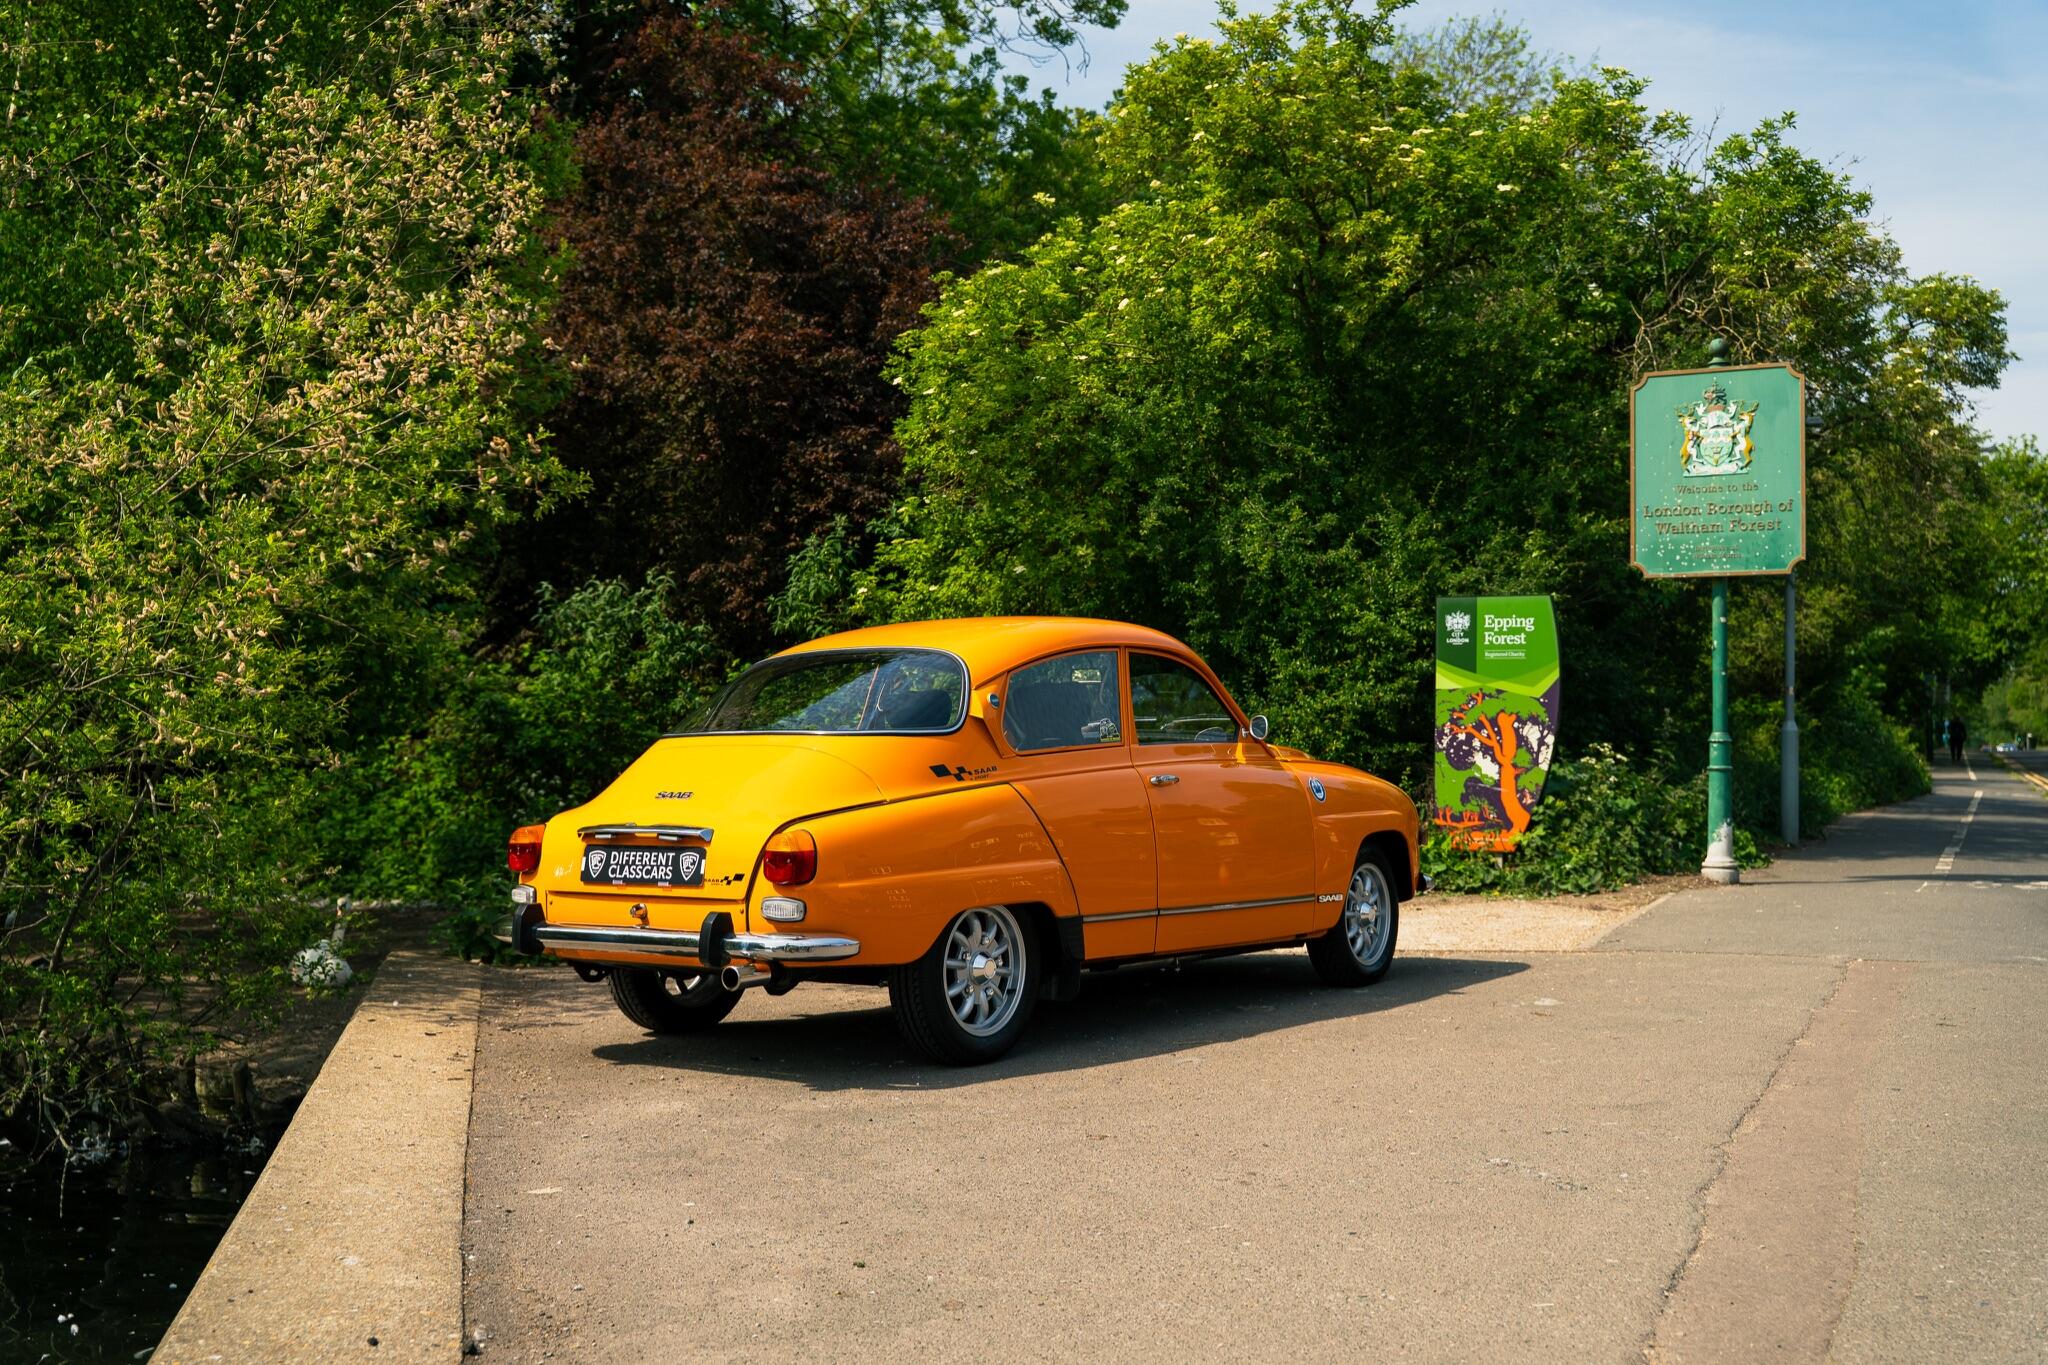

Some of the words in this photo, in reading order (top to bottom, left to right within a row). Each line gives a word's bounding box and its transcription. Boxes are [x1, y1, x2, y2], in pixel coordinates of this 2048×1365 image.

[1676, 485, 1723, 494] Welcome
[1728, 484, 1738, 492] to
[1743, 483, 1759, 491] the
[1643, 504, 1701, 518] London
[1706, 501, 1773, 516] Borough
[1778, 499, 1793, 512] of
[1655, 522, 1724, 535] Waltham
[1730, 518, 1782, 532] Forest
[1484, 614, 1535, 632] Epping
[1484, 631, 1526, 645] Forest
[974, 765, 998, 775] SAAB
[655, 791, 693, 799] SAAB
[610, 851, 675, 866] DIFFERENT
[608, 865, 673, 880] CLASSCARS
[1318, 894, 1343, 903] SAAB
